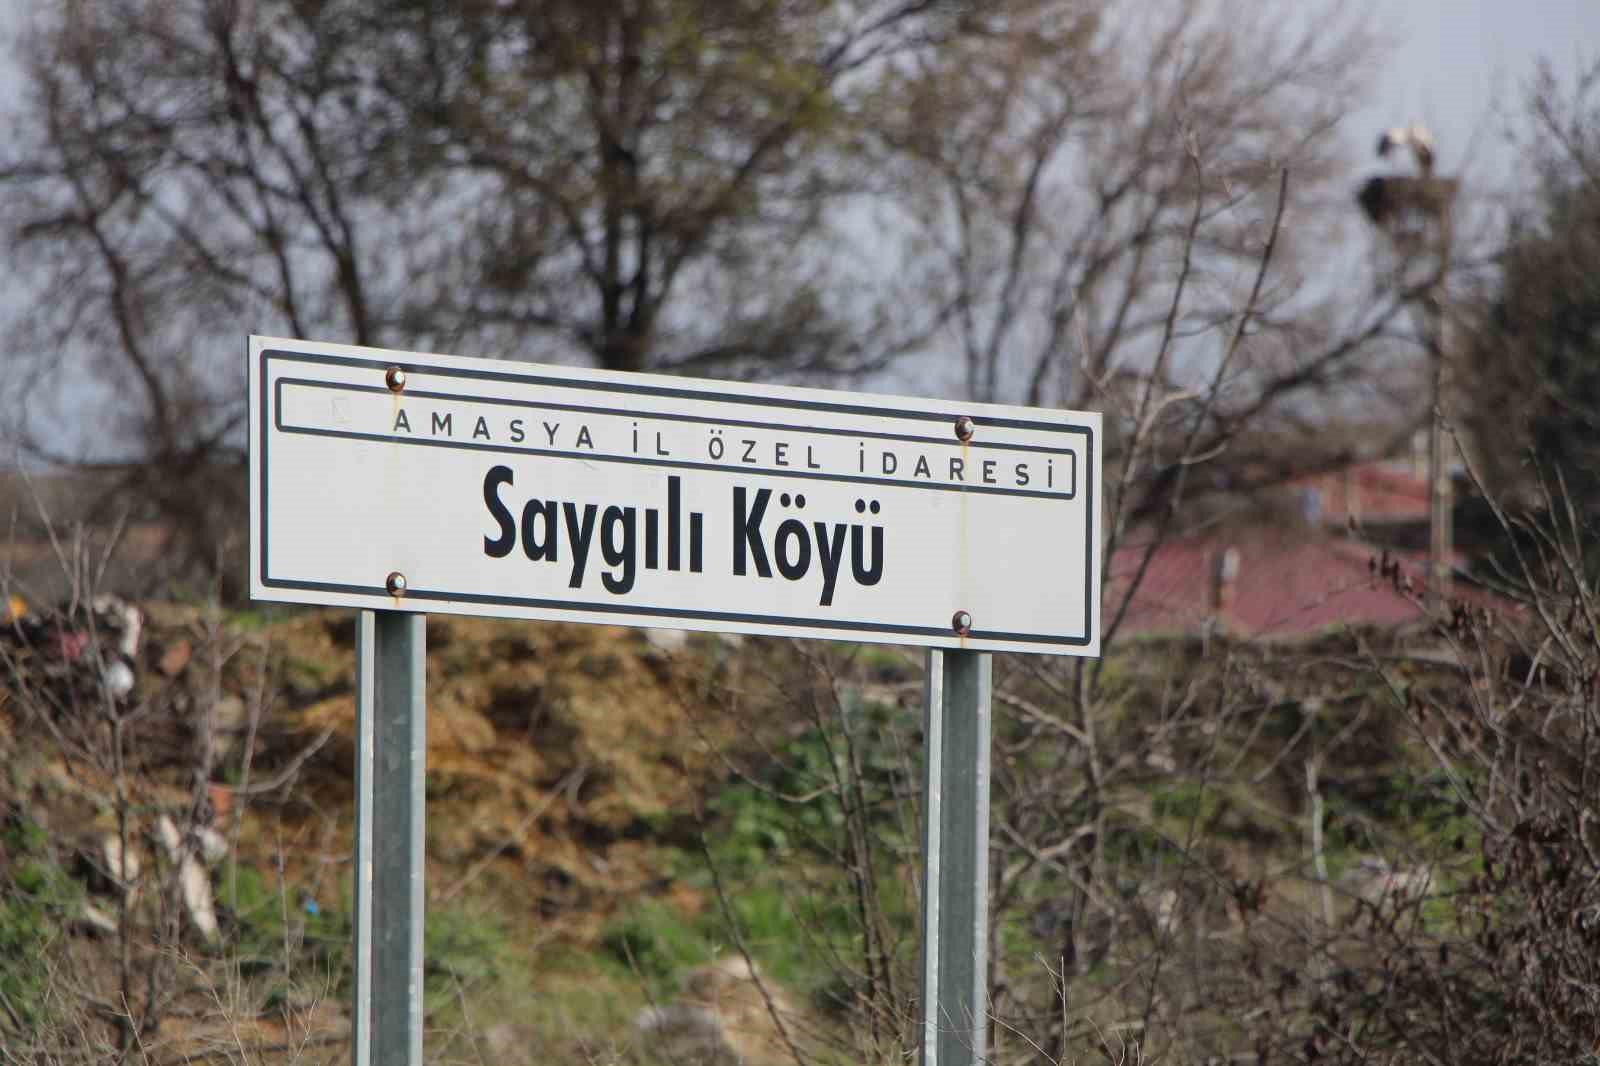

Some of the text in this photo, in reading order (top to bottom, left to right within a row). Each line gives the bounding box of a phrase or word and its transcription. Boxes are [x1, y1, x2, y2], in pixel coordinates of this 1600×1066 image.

[393, 409, 1053, 489] AMASYA İL ÖZEL İDARESİ
[483, 465, 884, 607] Saygılı Köyü
